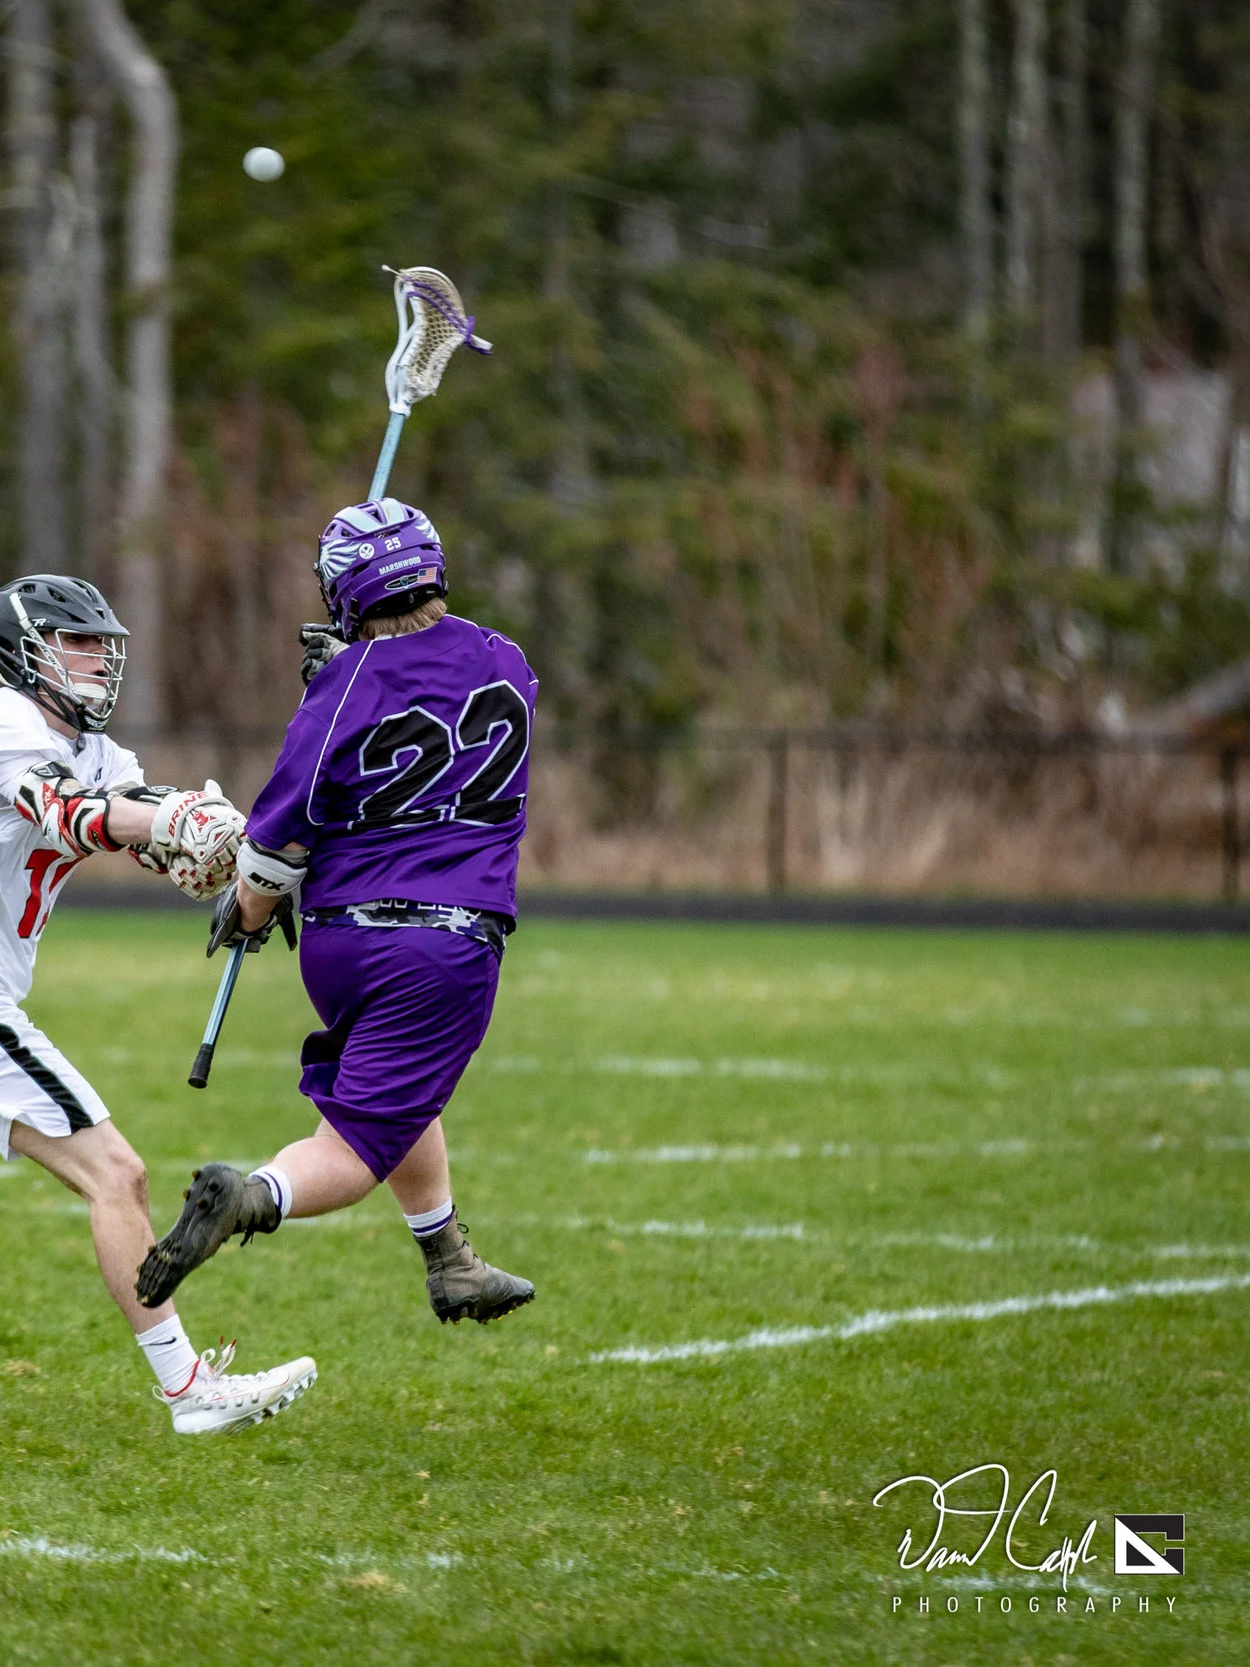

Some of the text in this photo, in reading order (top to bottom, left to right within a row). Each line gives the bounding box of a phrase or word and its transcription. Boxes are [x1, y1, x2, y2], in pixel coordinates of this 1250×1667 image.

[384, 536, 402, 552] 25
[378, 555, 422, 576] MARSHWOOD
[347, 679, 527, 830] 22
[168, 790, 208, 838] BRINE
